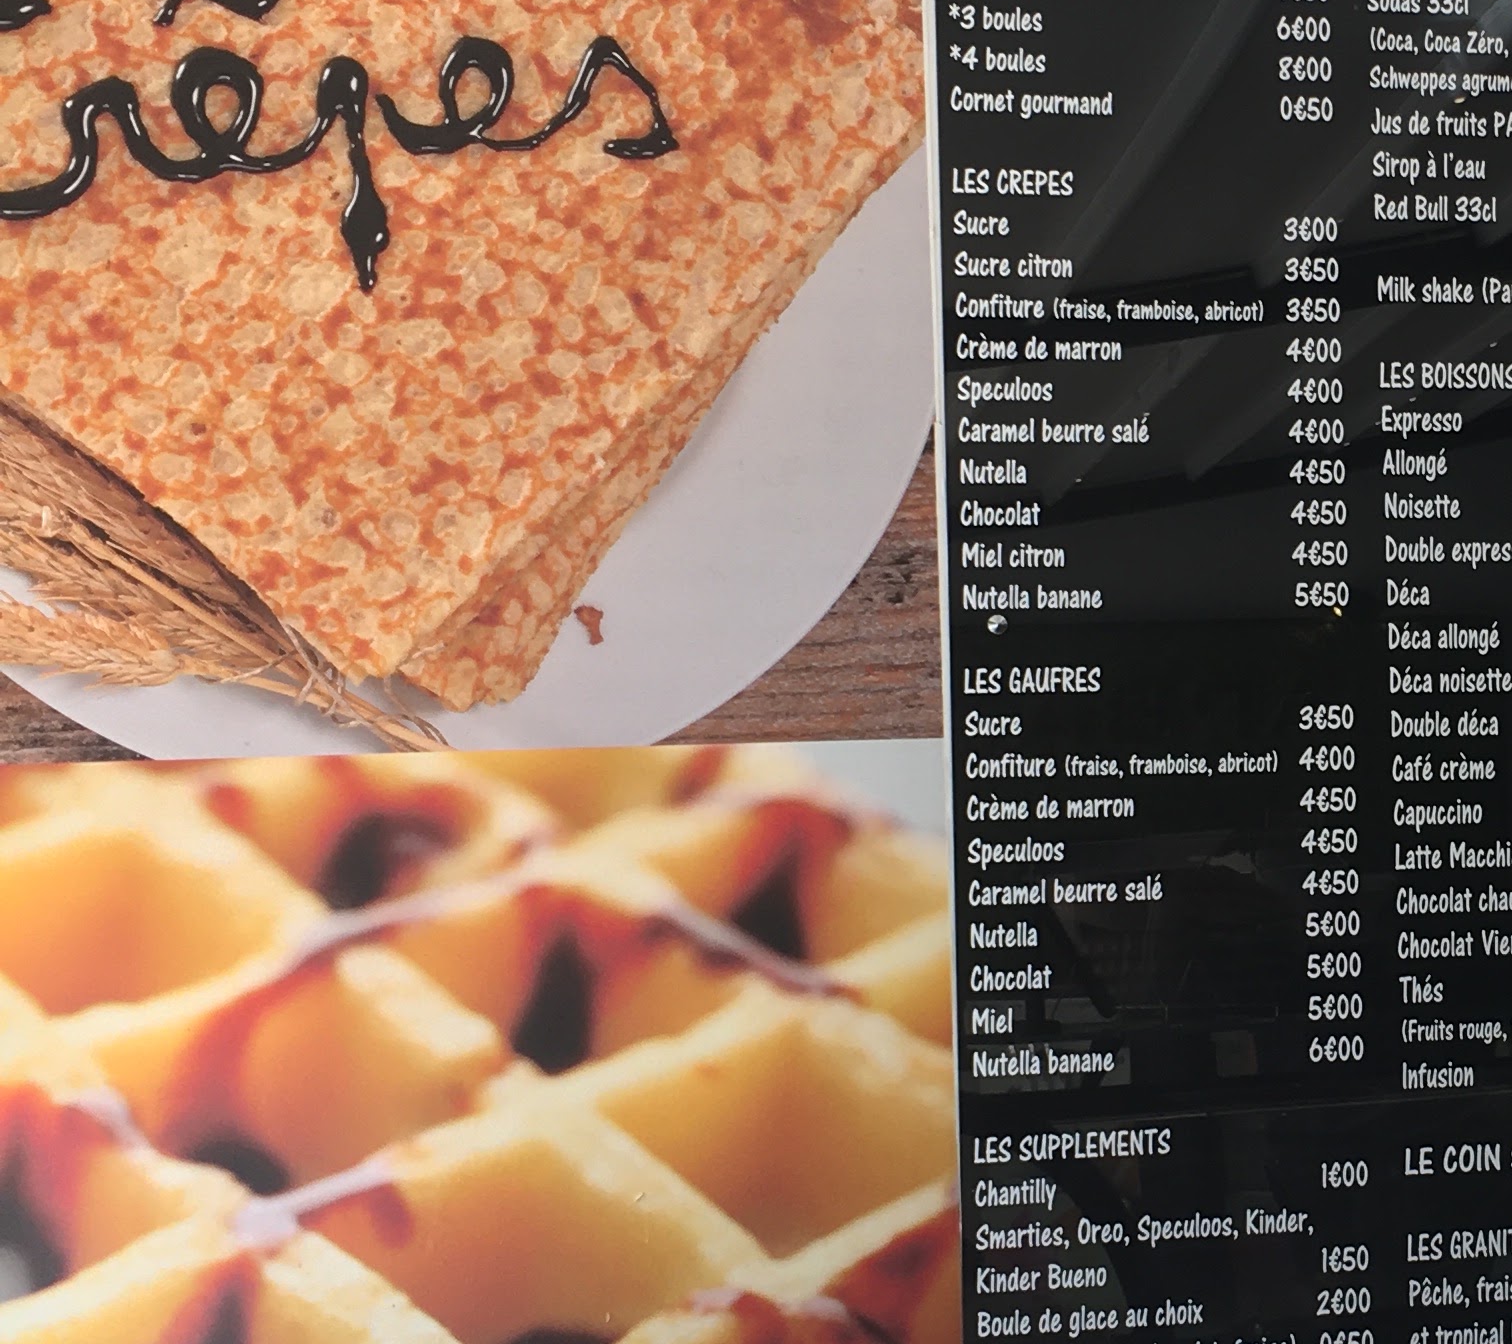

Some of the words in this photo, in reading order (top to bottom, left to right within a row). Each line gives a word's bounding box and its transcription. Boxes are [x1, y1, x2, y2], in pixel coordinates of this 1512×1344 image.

[1369, 64, 1457, 97] Schweppes
[950, 85, 1015, 113] Cornet
[1020, 91, 1113, 120] gourmand
[1280, 95, 1334, 122] 0€50
[1370, 107, 1402, 135] Jus
[1408, 110, 1431, 136] de
[1435, 110, 1487, 137] fruits
[952, 167, 990, 194] LES
[996, 168, 1074, 196] CREPES
[1373, 193, 1409, 221] Red
[1414, 194, 1449, 222] Bull
[1454, 196, 1497, 222] 33cl
[954, 250, 1011, 277] Sucre
[1017, 252, 1073, 278] citron
[1284, 256, 1339, 282] 3€50
[955, 291, 1045, 319] Confiture
[1053, 296, 1112, 323] (fraise,
[1116, 298, 1200, 324] framboise,
[1204, 299, 1264, 322] abricot)
[1285, 296, 1341, 323] 3€50
[956, 332, 1018, 360] Crème
[1024, 335, 1049, 360] de
[1055, 341, 1122, 361] marron
[1285, 337, 1342, 363] 4€00
[1379, 361, 1415, 389] LES
[957, 375, 1053, 408] Speculoos
[1287, 377, 1343, 404] 4€00
[958, 416, 1035, 443] Caramel
[1041, 417, 1106, 443] beurre
[1111, 416, 1150, 444] salé
[1288, 418, 1344, 444] 4€00
[1381, 404, 1463, 440] Expresso
[1385, 534, 1446, 563] Double
[962, 584, 1030, 610] Nutella
[1037, 584, 1103, 610] banane
[1294, 581, 1350, 607] 5€50
[963, 667, 1002, 695] LES
[1008, 666, 1101, 694] GAUFRES
[1393, 798, 1483, 834] Capuccino
[1394, 842, 1443, 871] Latte
[1397, 930, 1474, 960] Chocolat
[970, 963, 1053, 992] Chocolat
[1306, 951, 1362, 979] 5€00
[1402, 1061, 1474, 1090] Infusion
[973, 1136, 1012, 1164] LES
[1018, 1128, 1171, 1162] SUPPLEMENTS
[1404, 1146, 1434, 1176] LE
[1442, 1143, 1501, 1174] COIN
[974, 1177, 1057, 1211] Chantilly
[1321, 1160, 1369, 1189] 1€00
[975, 1221, 1070, 1251] Smarties,
[1077, 1217, 1130, 1247] Oreo,
[1137, 1212, 1239, 1248] Speculoos,
[1246, 1208, 1314, 1236] Kinder,
[976, 1266, 1042, 1294] Kinder
[1048, 1263, 1107, 1290] Bueno
[1321, 1244, 1369, 1274] 1€50
[977, 1308, 1032, 1338] Boule
[1038, 1307, 1063, 1334] de
[1068, 1304, 1119, 1338] glace
[1125, 1307, 1148, 1328] au
[1155, 1298, 1204, 1326] choix
[1316, 1286, 1371, 1316] 2€00
